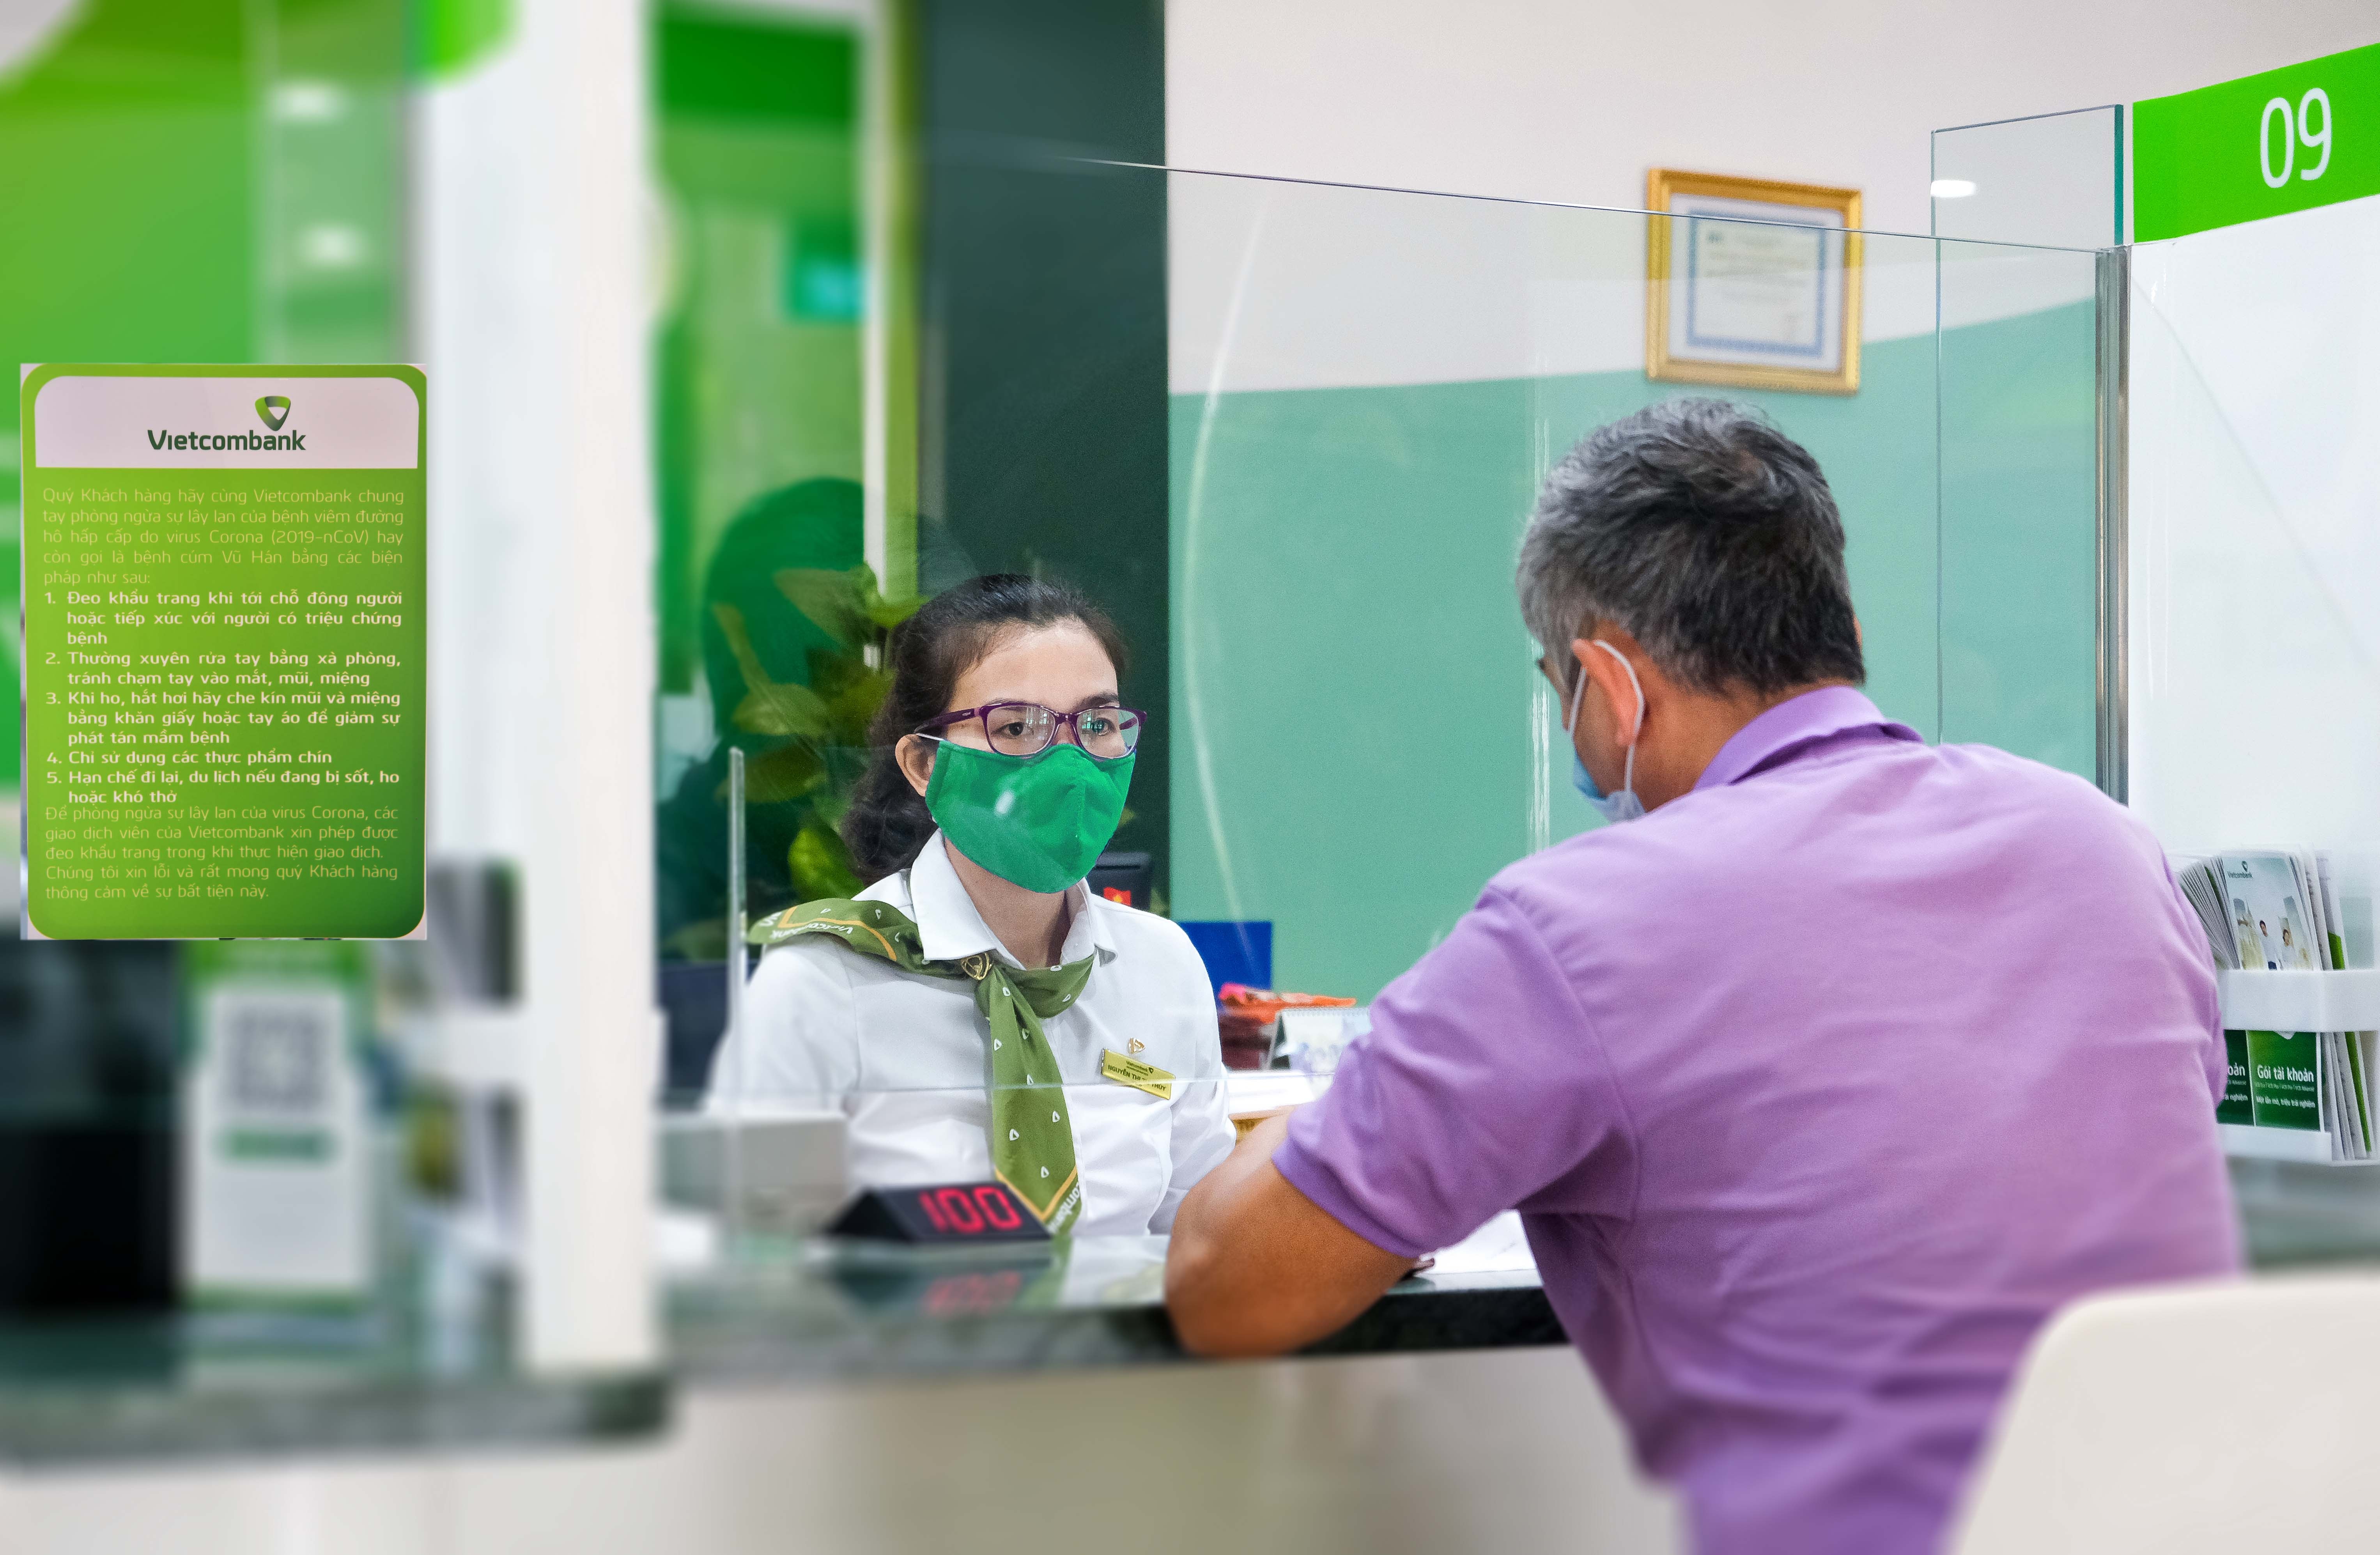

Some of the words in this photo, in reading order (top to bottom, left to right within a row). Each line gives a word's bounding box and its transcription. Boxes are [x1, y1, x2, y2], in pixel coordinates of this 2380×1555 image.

[2260, 87, 2332, 188] 09
[147, 429, 306, 450] Vietcombank
[43, 487, 74, 504] Quý
[81, 488, 128, 502] Khách
[134, 488, 171, 505] hàng
[178, 489, 205, 505] hãy
[211, 488, 247, 505] cùng
[253, 489, 352, 503] Vietcombank
[358, 489, 404, 505] chung
[42, 510, 66, 525] tay
[71, 509, 118, 526] phòng
[124, 509, 161, 526] ngừa
[166, 512, 184, 525] sự
[188, 509, 209, 526] lây
[214, 509, 236, 523] lan
[240, 509, 267, 523] của
[272, 509, 309, 525] bệnh
[314, 509, 350, 523] viêm
[355, 509, 404, 526] đường
[43, 529, 62, 543] hô
[71, 528, 98, 546] hấp
[106, 528, 132, 546] cấp
[140, 530, 159, 543] do
[166, 530, 200, 544] virus
[209, 530, 263, 544] Corona
[271, 529, 369, 545] (2019-nCoV)
[377, 530, 404, 546] hay
[43, 549, 71, 563] còn
[80, 550, 103, 566] gọi
[112, 549, 124, 563] là
[134, 549, 171, 566] bệnh
[180, 549, 212, 564] cúm
[221, 550, 241, 564] Vũ
[251, 550, 282, 564] Hán
[292, 547, 328, 567] bằng
[338, 550, 362, 564] các
[372, 550, 403, 566] biện
[44, 570, 81, 587] pháp
[87, 570, 117, 584] như
[122, 573, 150, 584] sau:
[44, 592, 56, 604] 1.
[67, 591, 101, 604] Đeo
[109, 589, 149, 604] khẩu
[156, 593, 200, 607] trang
[208, 591, 233, 604] khi
[241, 591, 262, 604] tới
[270, 589, 299, 604] chỗ
[307, 591, 348, 607] đông
[356, 591, 402, 607] người
[67, 611, 106, 627] hoặc
[114, 609, 145, 627] tiếp
[154, 611, 182, 624] xúc
[191, 611, 215, 624] với
[224, 611, 269, 627] người
[278, 611, 297, 625] có
[305, 611, 343, 627] triệu
[351, 611, 402, 627] chứng
[67, 631, 108, 646] bệnh
[45, 652, 60, 664] 2.
[67, 651, 131, 667] Thường
[140, 652, 190, 667] xuyên
[199, 652, 226, 664] rửa
[234, 653, 260, 667] tay
[269, 648, 308, 667] bằng
[318, 652, 337, 664] xà
[346, 651, 400, 667] phòng,
[67, 671, 111, 684] tránh
[117, 671, 161, 687] chạm
[168, 673, 194, 687] tay
[200, 671, 229, 684] vào
[236, 669, 272, 686] mắt,
[279, 671, 313, 686] mũi,
[320, 671, 370, 687] miệng
[46, 692, 61, 705] 3.
[68, 691, 94, 704] Khi
[100, 692, 125, 707] ho,
[131, 689, 157, 704] hắt
[163, 691, 187, 704] hơi
[193, 691, 221, 707] hãy
[227, 691, 255, 704] che
[261, 691, 286, 704] kín
[291, 691, 321, 704] mũi
[326, 691, 345, 704] và
[351, 691, 400, 707] miệng
[68, 709, 107, 727] bằng
[115, 711, 155, 724] khăn
[162, 709, 195, 726] giấy
[203, 711, 241, 726] hoặc
[248, 712, 274, 726] tay
[281, 711, 300, 724] áo
[307, 708, 328, 724] để
[335, 711, 374, 726] giảm
[382, 714, 401, 726] sự
[68, 731, 104, 747] phát
[110, 731, 136, 744] tán
[143, 729, 184, 744] mầm
[190, 730, 230, 746] bệnh
[46, 752, 62, 764] 4.
[69, 751, 94, 764] Chỉ
[101, 751, 120, 763] sử
[126, 751, 166, 766] dụng
[172, 750, 198, 763] các
[205, 751, 241, 765] thực
[247, 747, 292, 766] phẩm
[298, 750, 332, 763] chín
[47, 771, 62, 784] 5.
[69, 771, 102, 786] Hạn
[107, 769, 137, 783] chế
[141, 770, 156, 783] đi
[161, 770, 183, 785] lại,
[189, 770, 208, 783] du
[214, 770, 241, 785] lịch
[246, 769, 275, 783] nếu
[280, 770, 321, 786] đang
[326, 770, 340, 785] bị
[345, 768, 374, 785] sốt,
[379, 770, 400, 783] ho
[69, 790, 106, 805] hoặc
[113, 790, 143, 803] khó
[149, 790, 177, 803] thở
[45, 804, 67, 820] Để
[73, 806, 119, 823] phòng
[125, 806, 162, 822] ngừa
[167, 809, 184, 821] sự
[189, 805, 210, 821] lây
[215, 806, 236, 819] lan
[241, 806, 267, 819] của
[272, 806, 306, 819] virus
[312, 805, 368, 821] Corona,
[374, 805, 398, 819] các
[2257, 1064, 2272, 1080] Gói
[2273, 1066, 2285, 1080] tài
[918, 1185, 1023, 1233] 100
